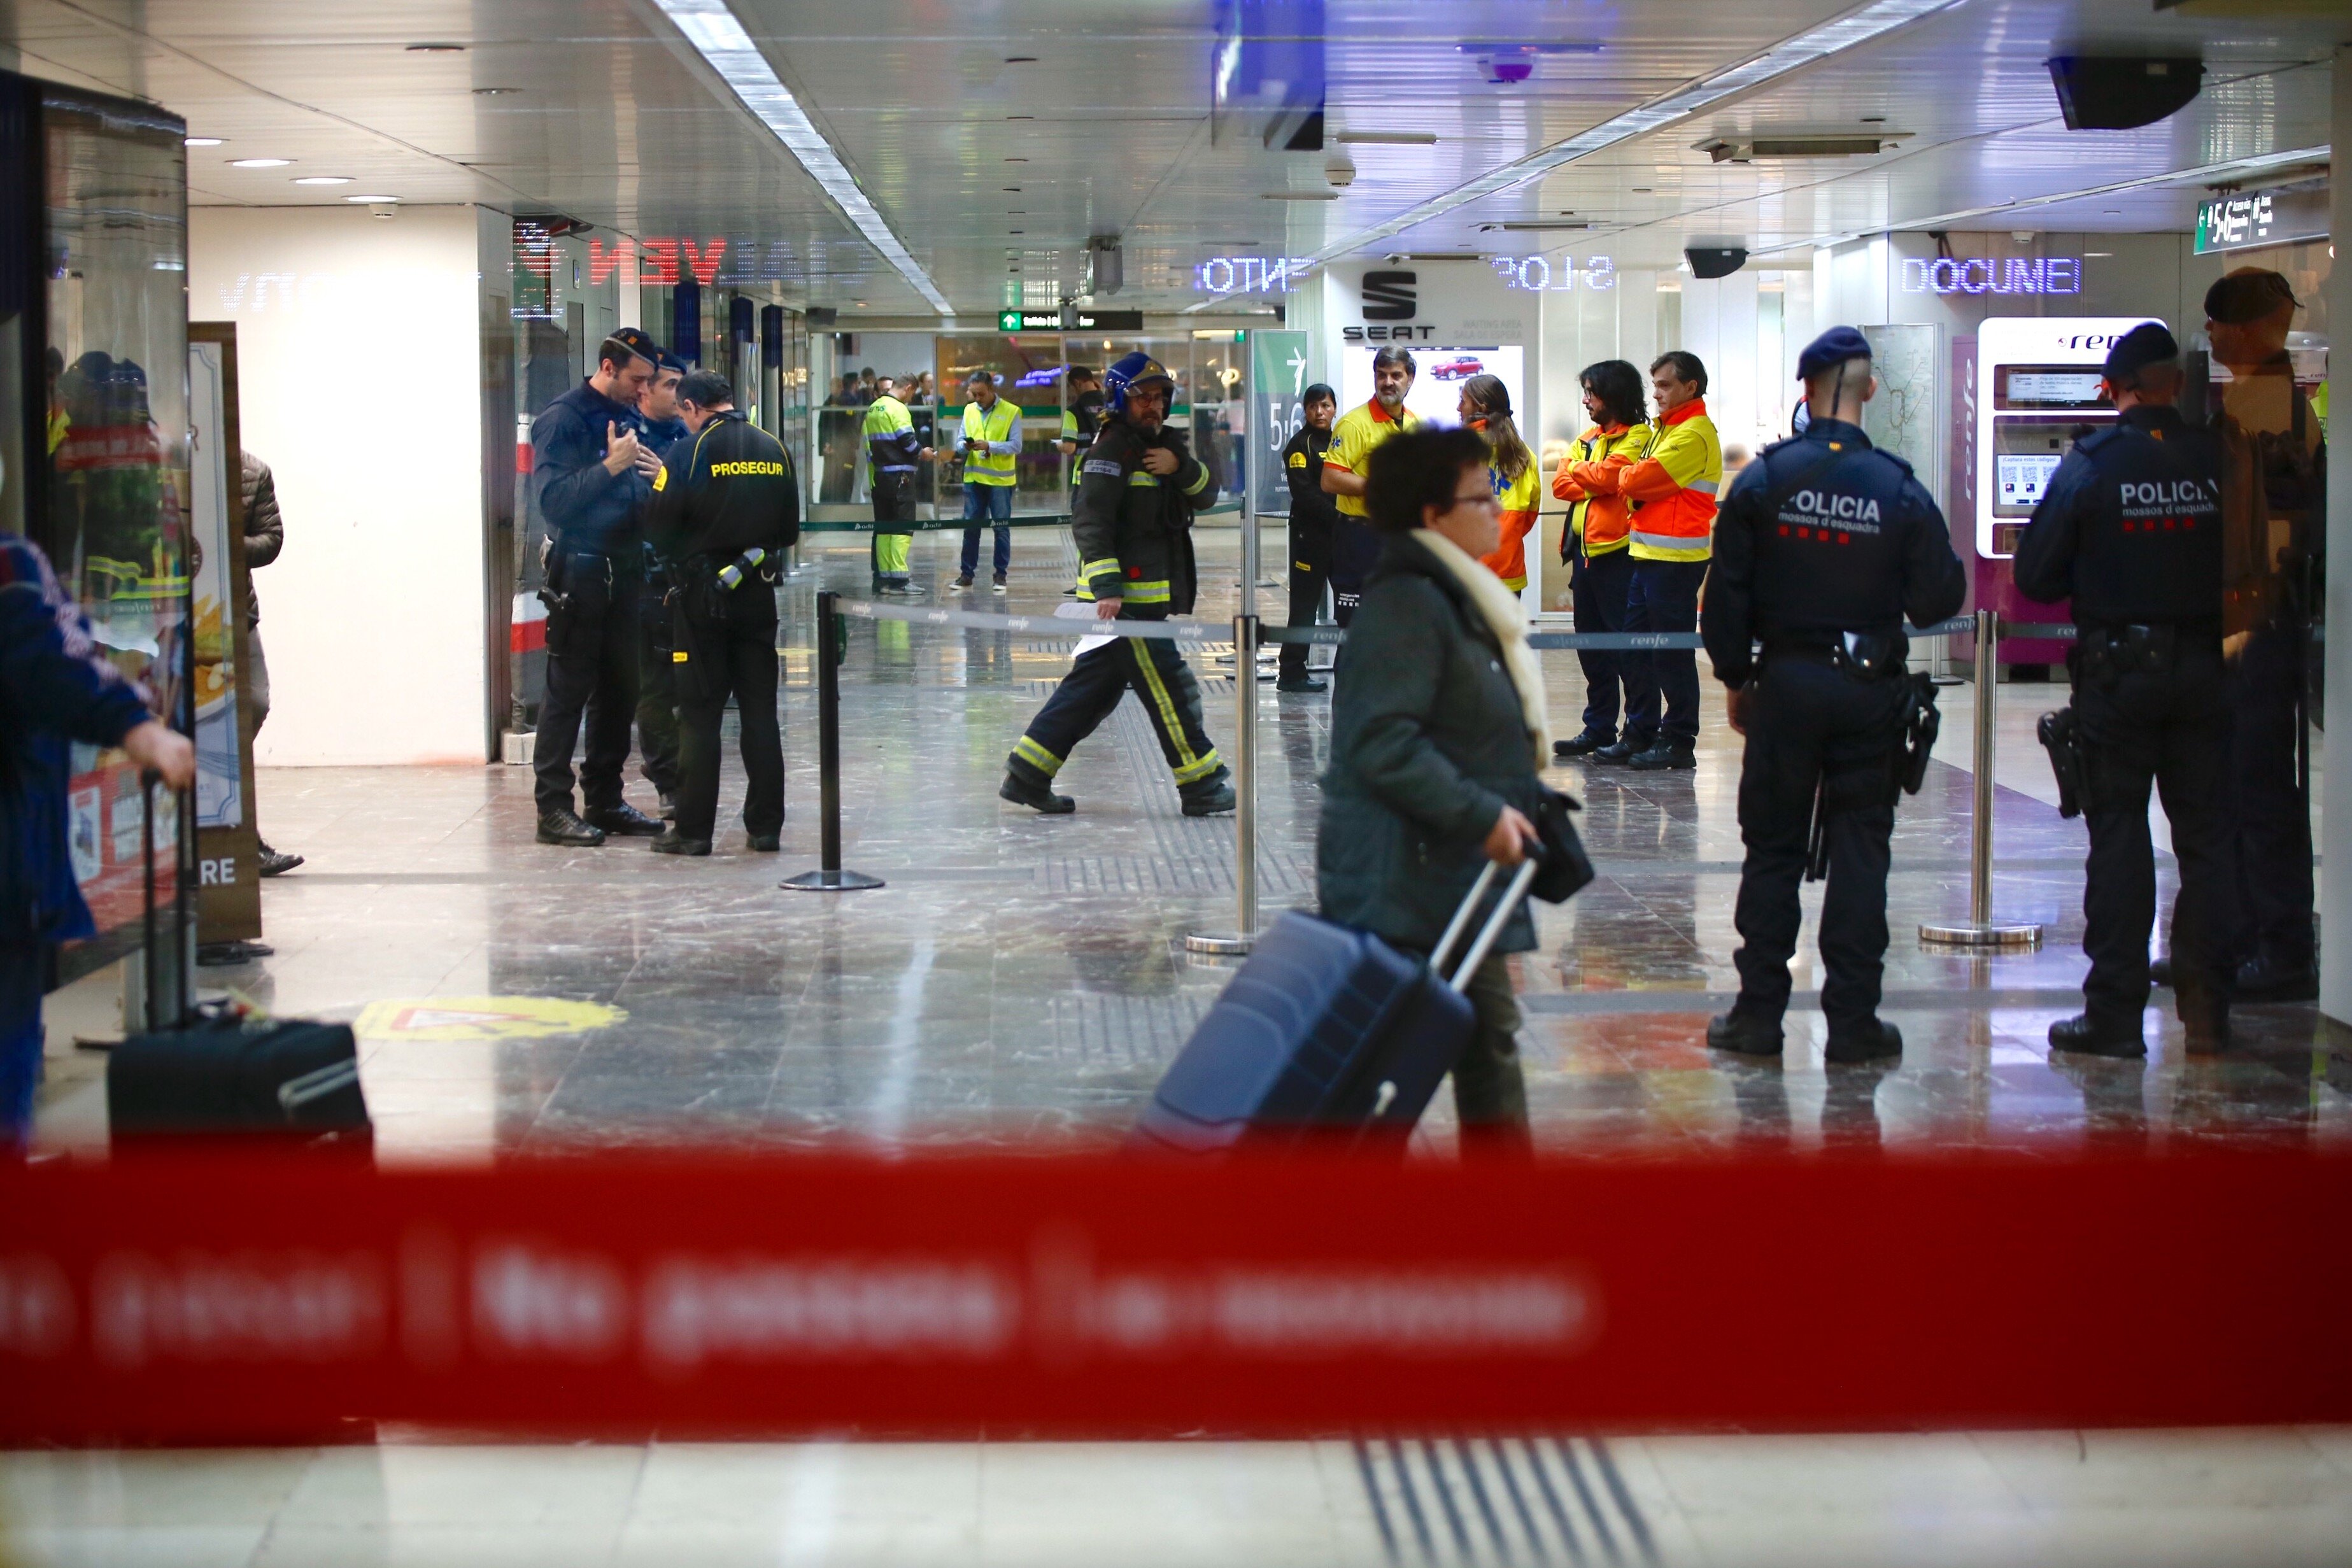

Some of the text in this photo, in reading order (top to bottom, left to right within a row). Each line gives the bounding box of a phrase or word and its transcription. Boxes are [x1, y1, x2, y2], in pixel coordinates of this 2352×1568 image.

[1343, 325, 1436, 340] SEAT
[1963, 358, 1975, 500] renfe
[711, 461, 784, 477] PROSEGUR
[1780, 489, 1881, 523] OLICIA
[2122, 501, 2218, 516] mossos d'esquadr
[1778, 511, 1819, 525] mossos
[852, 604, 872, 615] renfe
[928, 610, 949, 624] renfe
[1008, 616, 1030, 630] renfe
[1091, 621, 1115, 635] renfe
[1179, 624, 1203, 637] renfe
[1630, 633, 1669, 648] renfe
